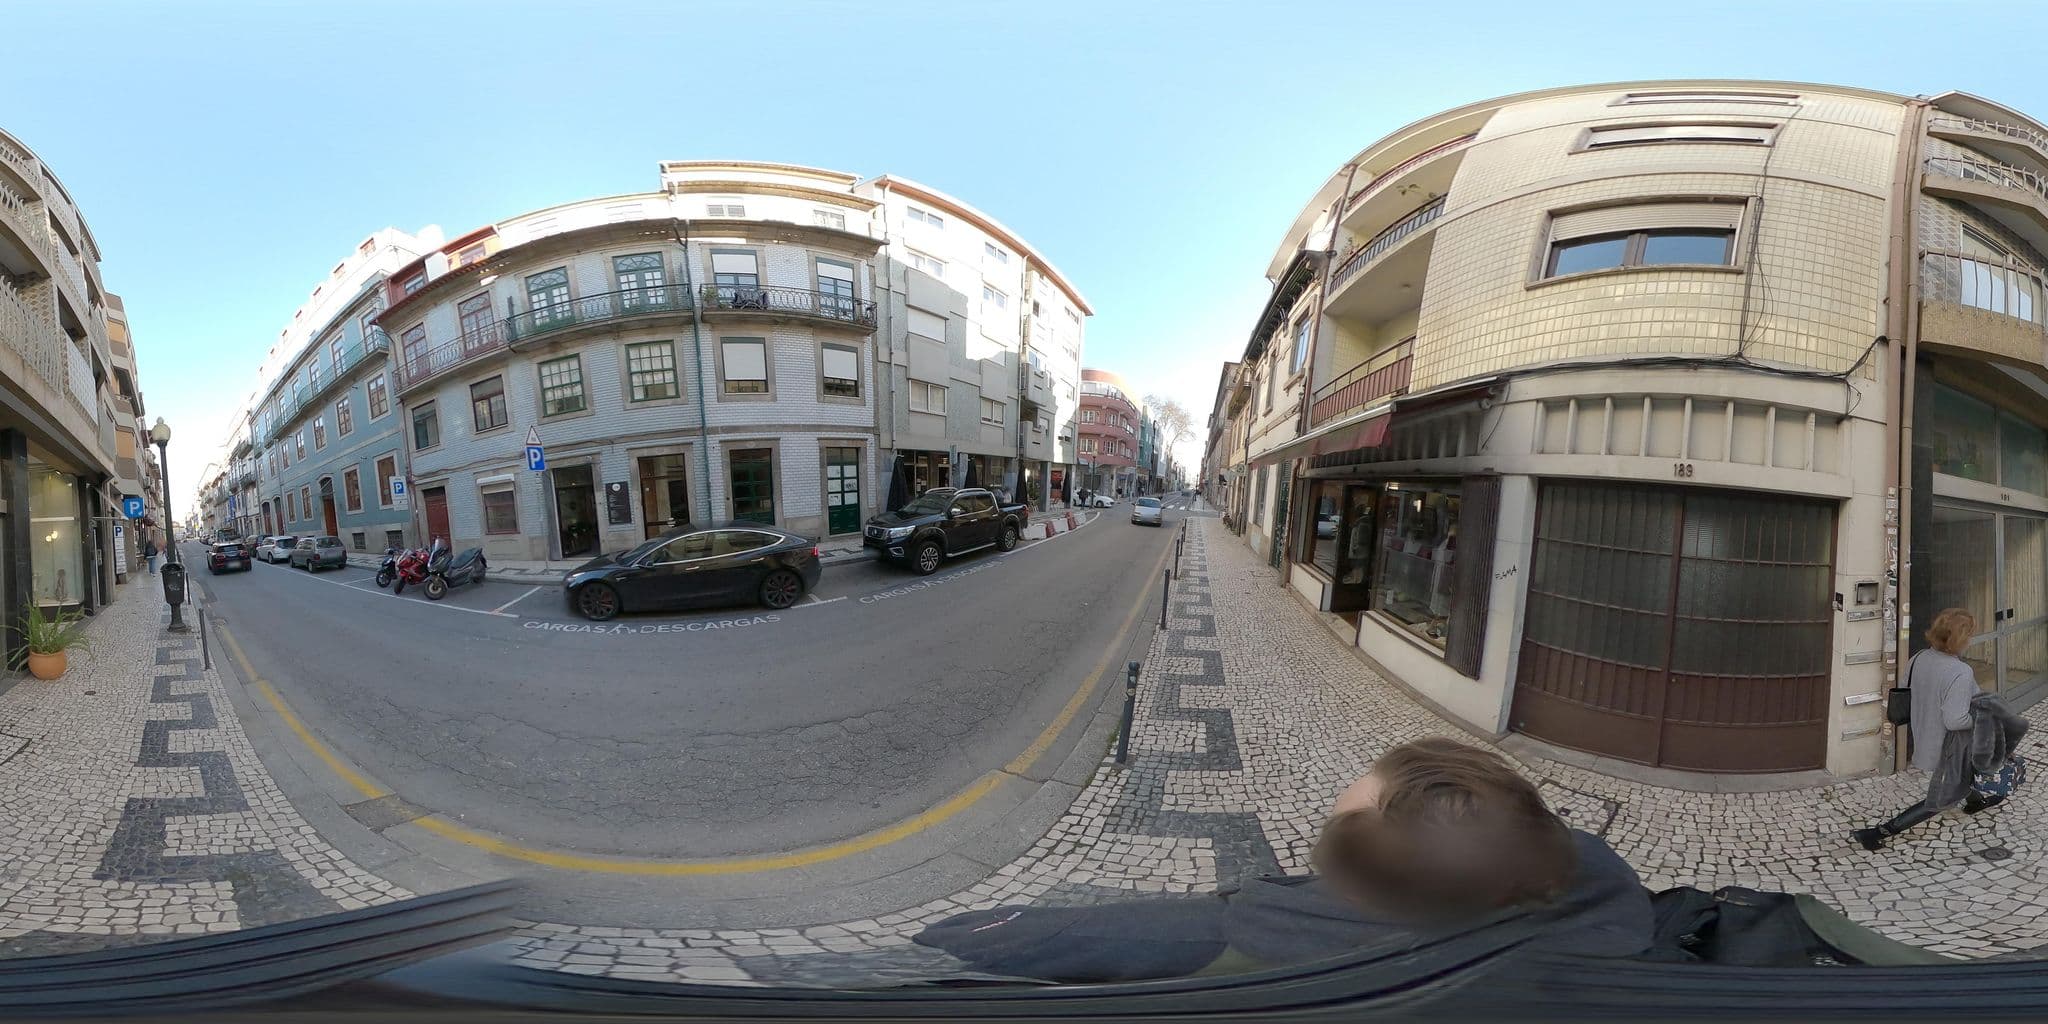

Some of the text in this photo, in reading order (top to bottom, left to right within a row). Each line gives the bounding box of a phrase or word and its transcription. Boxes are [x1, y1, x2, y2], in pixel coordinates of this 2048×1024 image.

[530, 449, 541, 469] P
[1673, 463, 1694, 478] 189
[394, 483, 403, 494] P
[129, 501, 140, 515] P
[115, 526, 123, 537] P
[523, 614, 781, 634] CARGAS DESCARGAS
